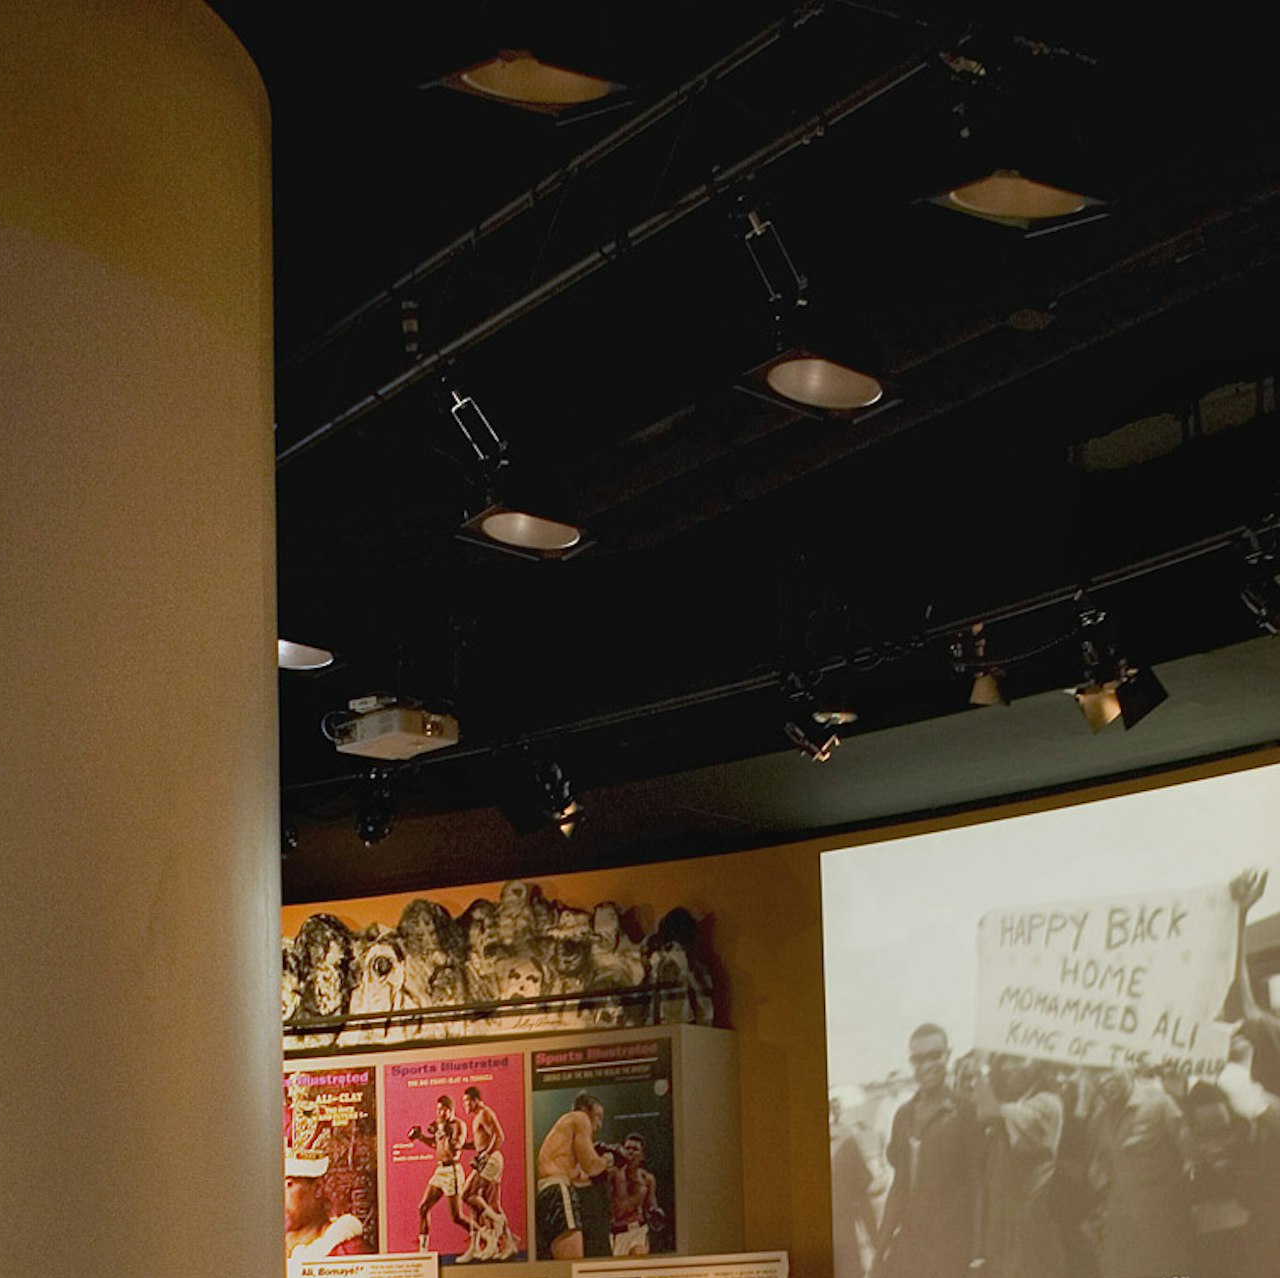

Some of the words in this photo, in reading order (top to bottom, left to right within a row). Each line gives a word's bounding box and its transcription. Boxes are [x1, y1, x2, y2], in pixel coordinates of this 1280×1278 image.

[1000, 909, 1090, 952] HAPPY
[1105, 906, 1187, 950] BACK
[1060, 958, 1148, 999] HOME
[1000, 985, 1138, 1034] MOHAMMED
[1152, 1009, 1199, 1050] ALI
[535, 1050, 584, 1066] Sports
[1005, 1020, 1061, 1053] KING
[1067, 1037, 1097, 1056] OF
[1109, 1043, 1151, 1067] THE
[391, 1064, 437, 1078] Sports
[441, 1057, 509, 1072] Illustrated
